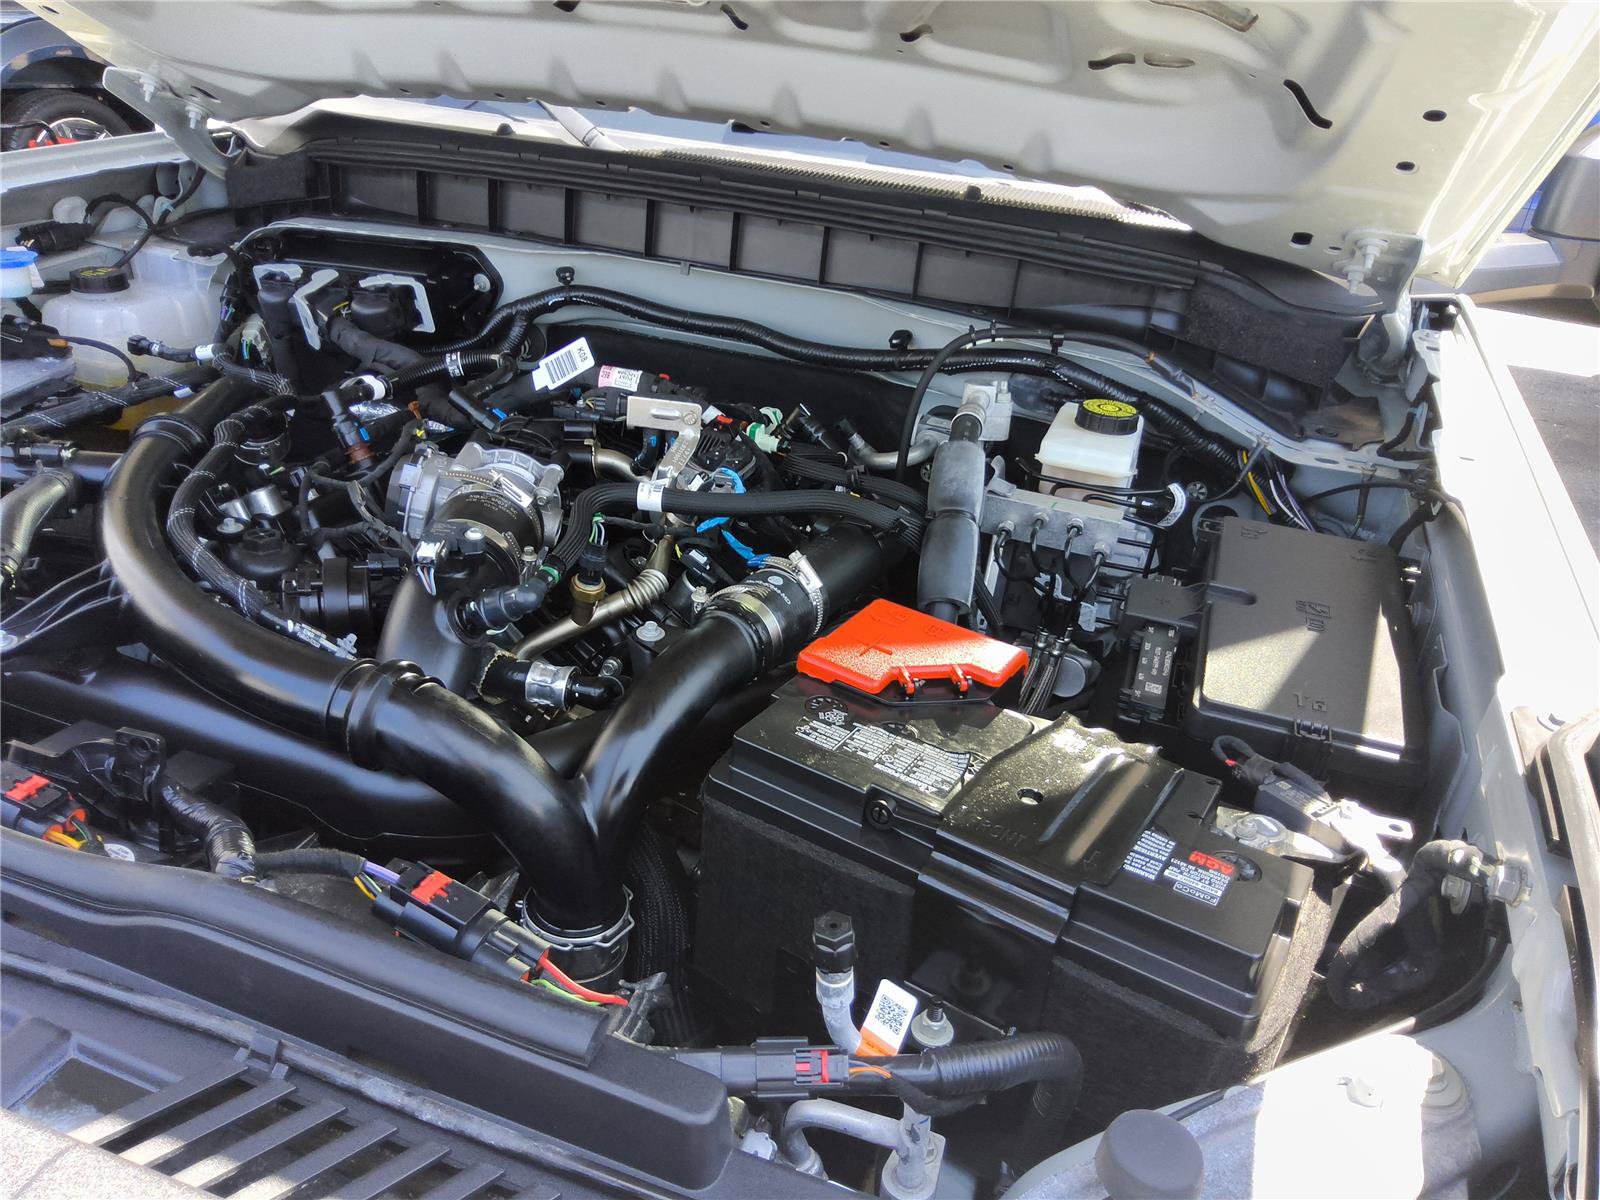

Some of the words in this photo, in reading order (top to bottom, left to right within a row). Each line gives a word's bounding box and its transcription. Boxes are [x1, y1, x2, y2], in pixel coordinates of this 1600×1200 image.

[576, 346, 588, 363] K08
[1189, 851, 1235, 875] AGM
[1175, 883, 1216, 903] FoMoCo
